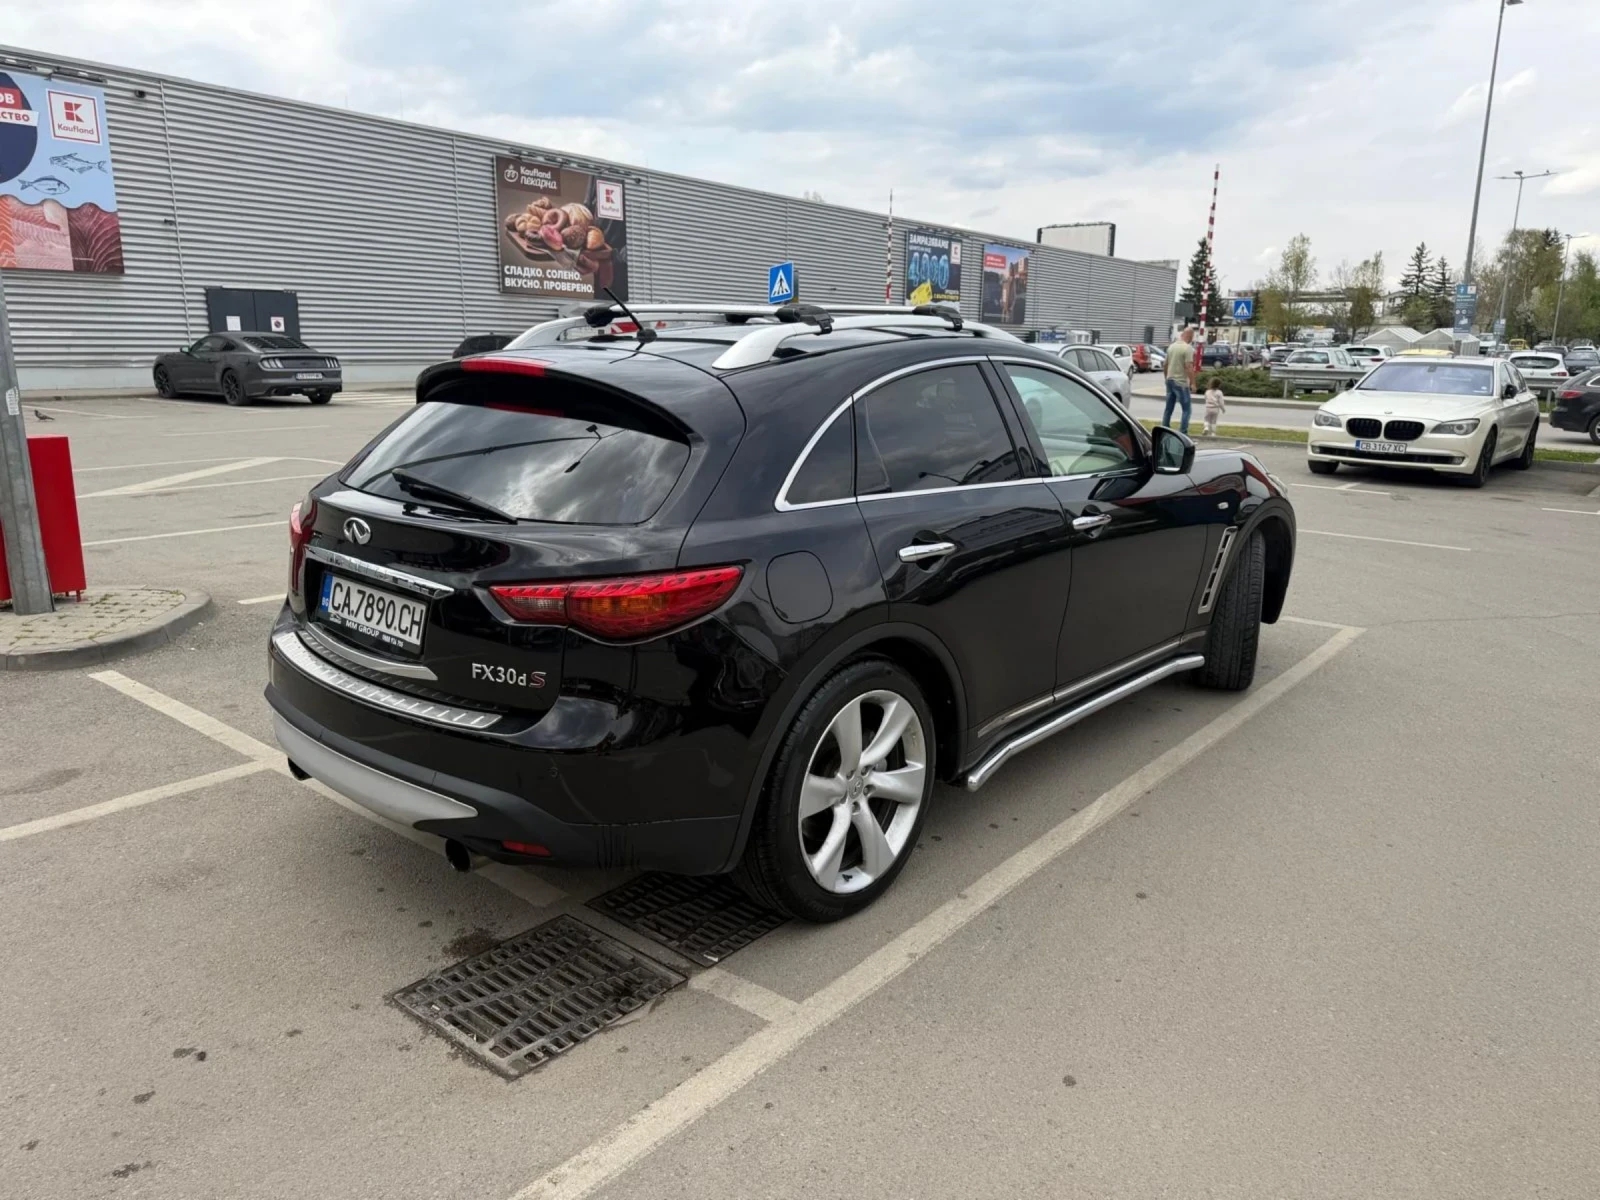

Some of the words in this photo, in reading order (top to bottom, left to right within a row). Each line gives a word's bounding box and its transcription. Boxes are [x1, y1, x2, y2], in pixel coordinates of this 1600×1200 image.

[0, 111, 30, 122] СТВО
[57, 123, 94, 135] Kaufland
[520, 165, 552, 179] Kaufland
[504, 264, 544, 278] СЛАДКО.
[546, 269, 582, 281] СОЛЕНО.
[504, 277, 542, 289] ВКУСНО.
[543, 280, 594, 294] ПРОВЕРЕНО.
[1371, 443, 1392, 452] 3167
[1393, 444, 1404, 453] XC
[345, 620, 357, 629] MM
[358, 624, 380, 637] GROUP
